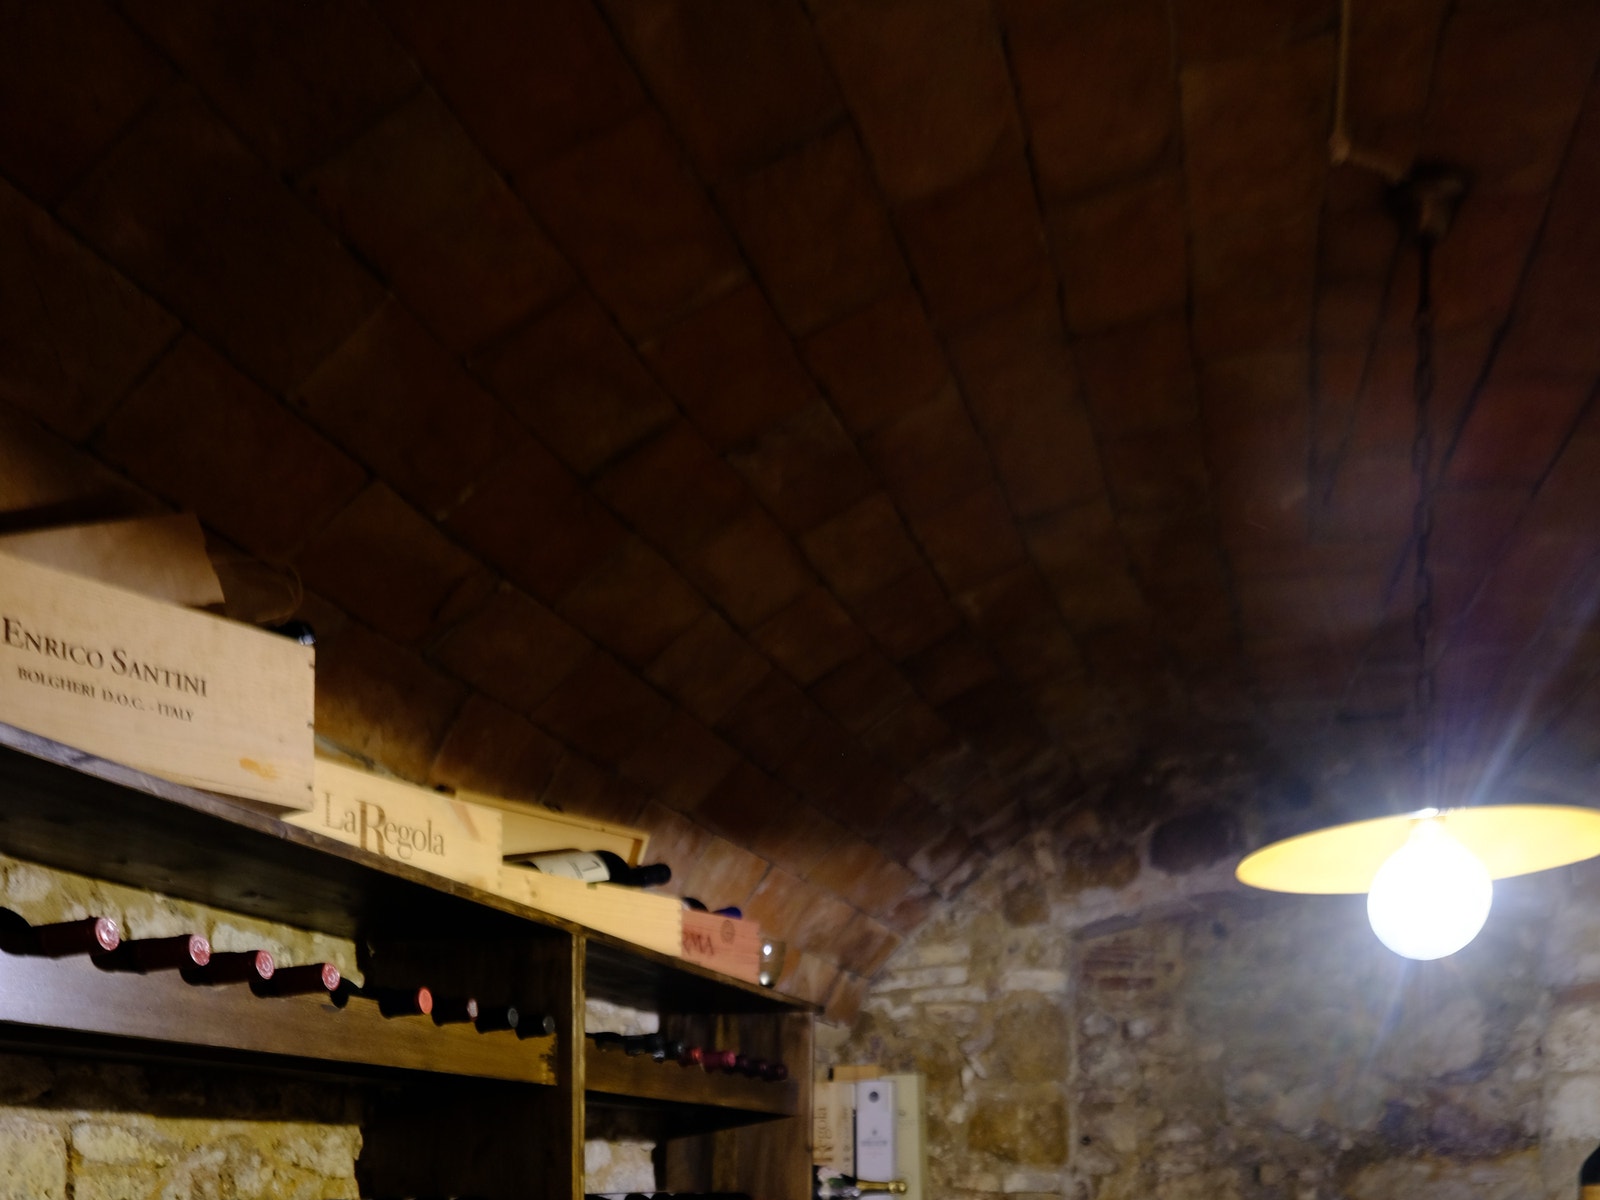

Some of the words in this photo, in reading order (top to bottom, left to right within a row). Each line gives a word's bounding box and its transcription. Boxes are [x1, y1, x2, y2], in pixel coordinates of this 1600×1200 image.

[3, 616, 104, 670] ENRICO
[110, 647, 208, 698] SANTINI
[17, 666, 96, 699] BOLGHERI
[157, 701, 194, 722] ITALY
